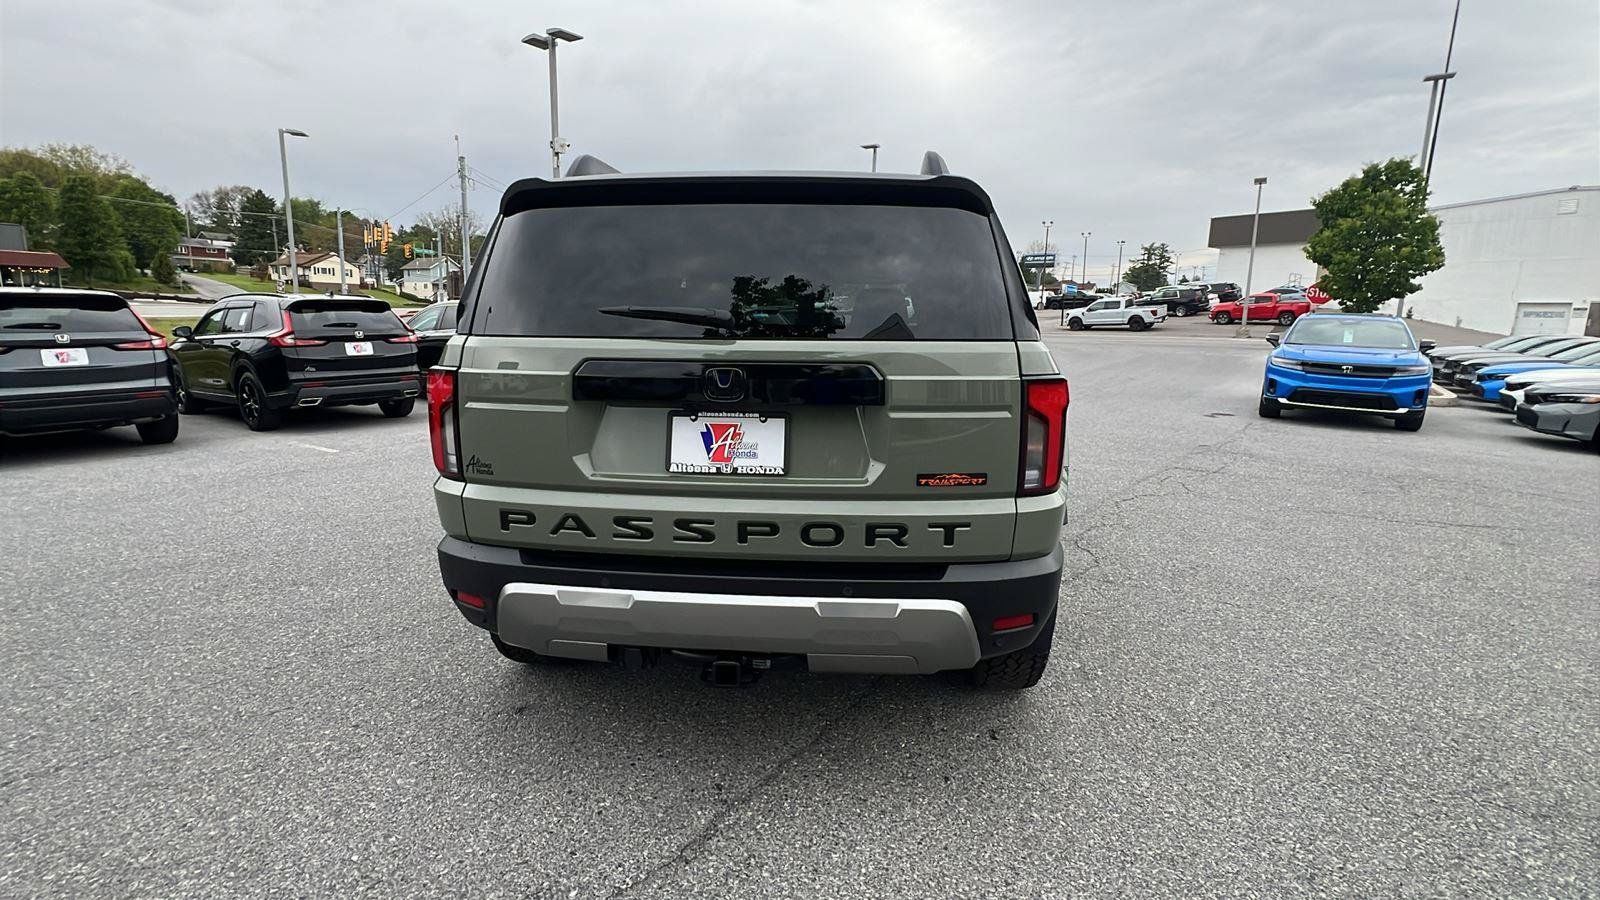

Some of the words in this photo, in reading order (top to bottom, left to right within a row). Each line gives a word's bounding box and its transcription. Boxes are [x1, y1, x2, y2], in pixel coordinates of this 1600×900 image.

[1308, 287, 1329, 298] STO
[728, 449, 758, 458] Honda
[669, 463, 717, 473] Altoona
[737, 466, 785, 474] HONDA
[919, 478, 986, 486] TRAILSPORT
[499, 508, 972, 549] PASSPORT
